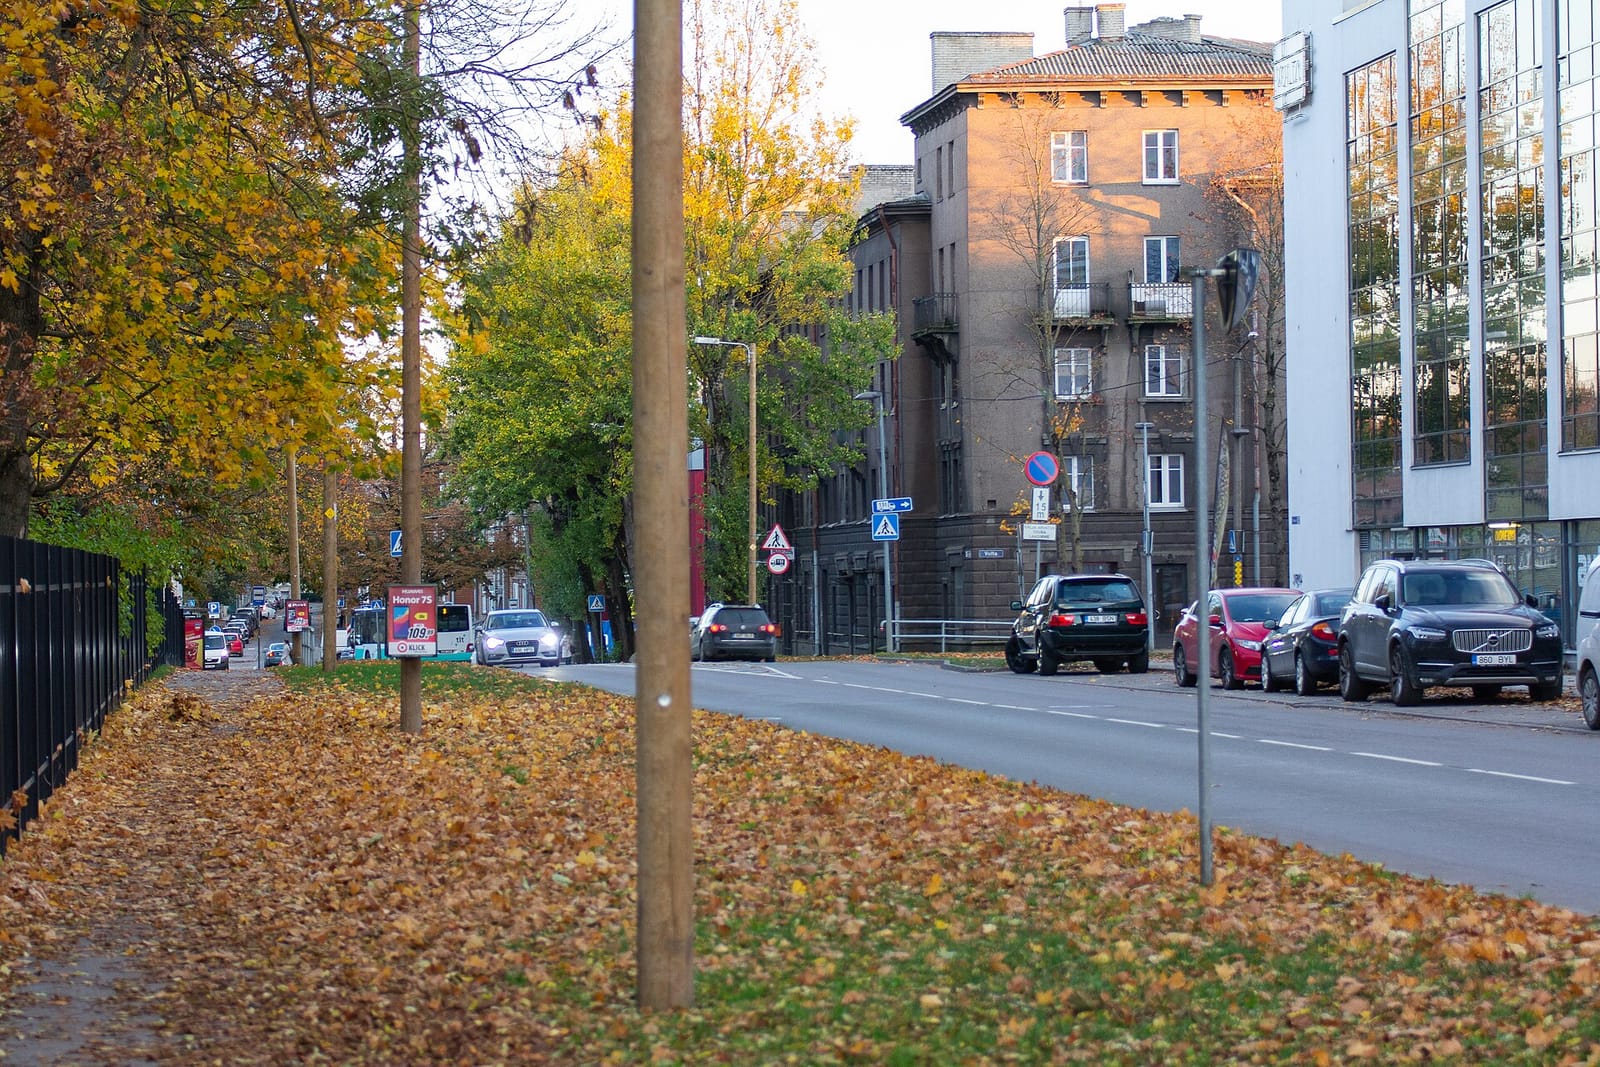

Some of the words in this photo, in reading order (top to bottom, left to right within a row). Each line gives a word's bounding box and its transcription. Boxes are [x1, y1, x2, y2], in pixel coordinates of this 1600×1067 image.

[1036, 502, 1047, 511] 15
[392, 596, 420, 604] Honor
[421, 596, 433, 604] 7S
[1479, 656, 1493, 664] 860
[1498, 655, 1513, 664] BYL
